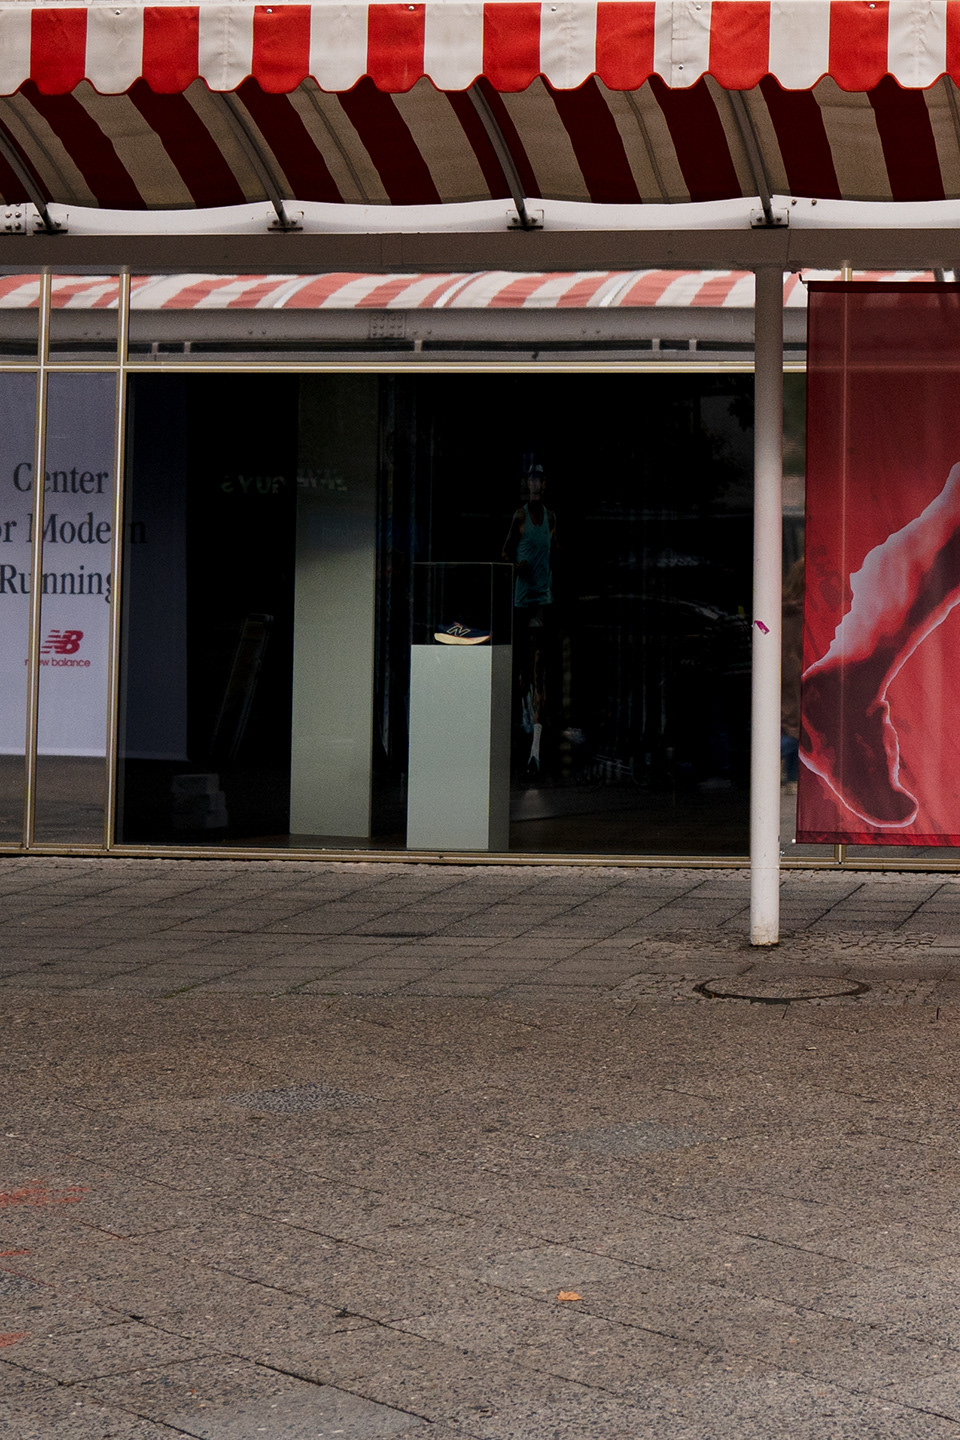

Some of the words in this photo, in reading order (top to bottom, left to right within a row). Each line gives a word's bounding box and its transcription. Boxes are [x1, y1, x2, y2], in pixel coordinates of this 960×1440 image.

[0, 520, 17, 543] r
[26, 511, 148, 544] Moden
[51, 657, 91, 668] balance
